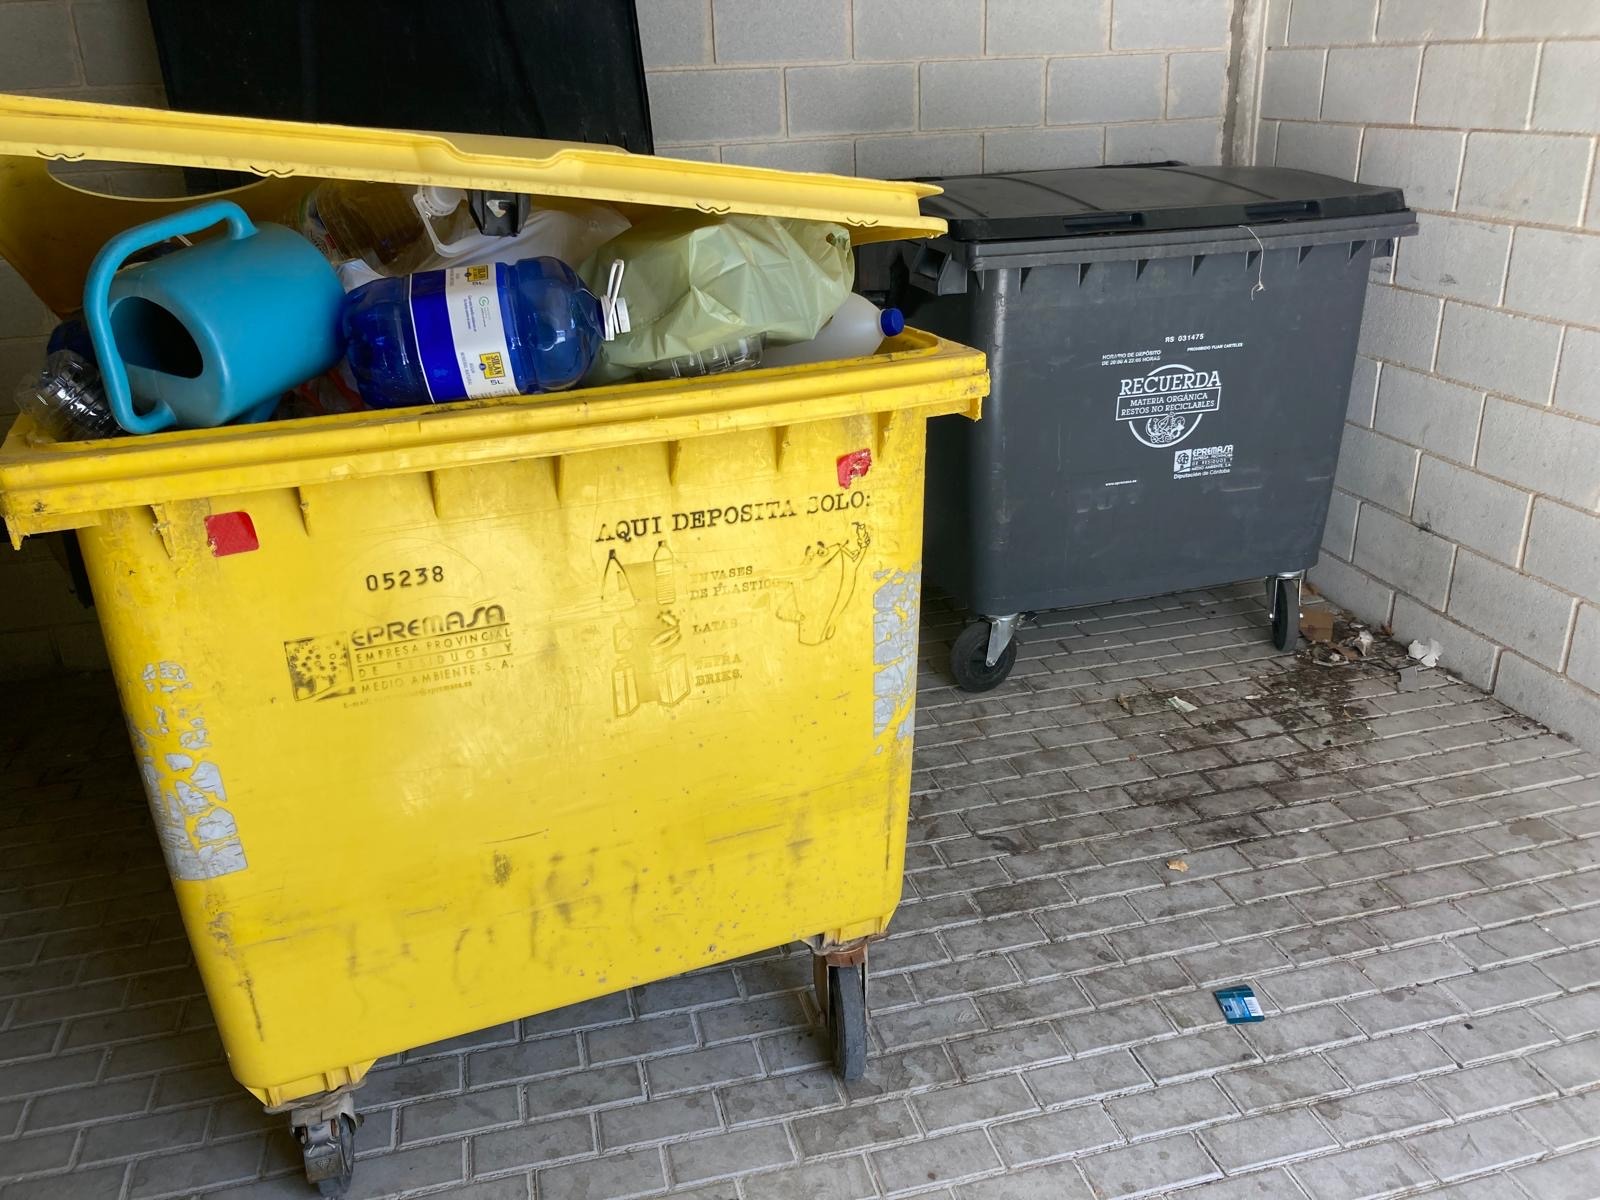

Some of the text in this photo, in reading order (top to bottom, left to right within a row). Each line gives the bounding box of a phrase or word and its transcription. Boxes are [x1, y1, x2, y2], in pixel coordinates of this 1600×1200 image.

[1178, 333, 1204, 342] 031475
[1119, 370, 1222, 396] RECUERDA
[1121, 406, 1150, 416] RESTOS
[1165, 400, 1215, 412] RECICLABLES
[1130, 392, 1208, 406] MATERIA ORGÁNICA
[1192, 444, 1234, 456] EPREMASA
[595, 516, 662, 542] AQUI
[672, 499, 797, 531] DEPOSITA
[366, 565, 444, 592] 05238
[690, 588, 708, 600] DE
[352, 604, 506, 646] EPREMASA
[356, 628, 512, 663] EMPRESA PROVINCIAL
[360, 666, 378, 678] DE
[504, 643, 512, 652] Y
[362, 678, 404, 692] MEDIO
